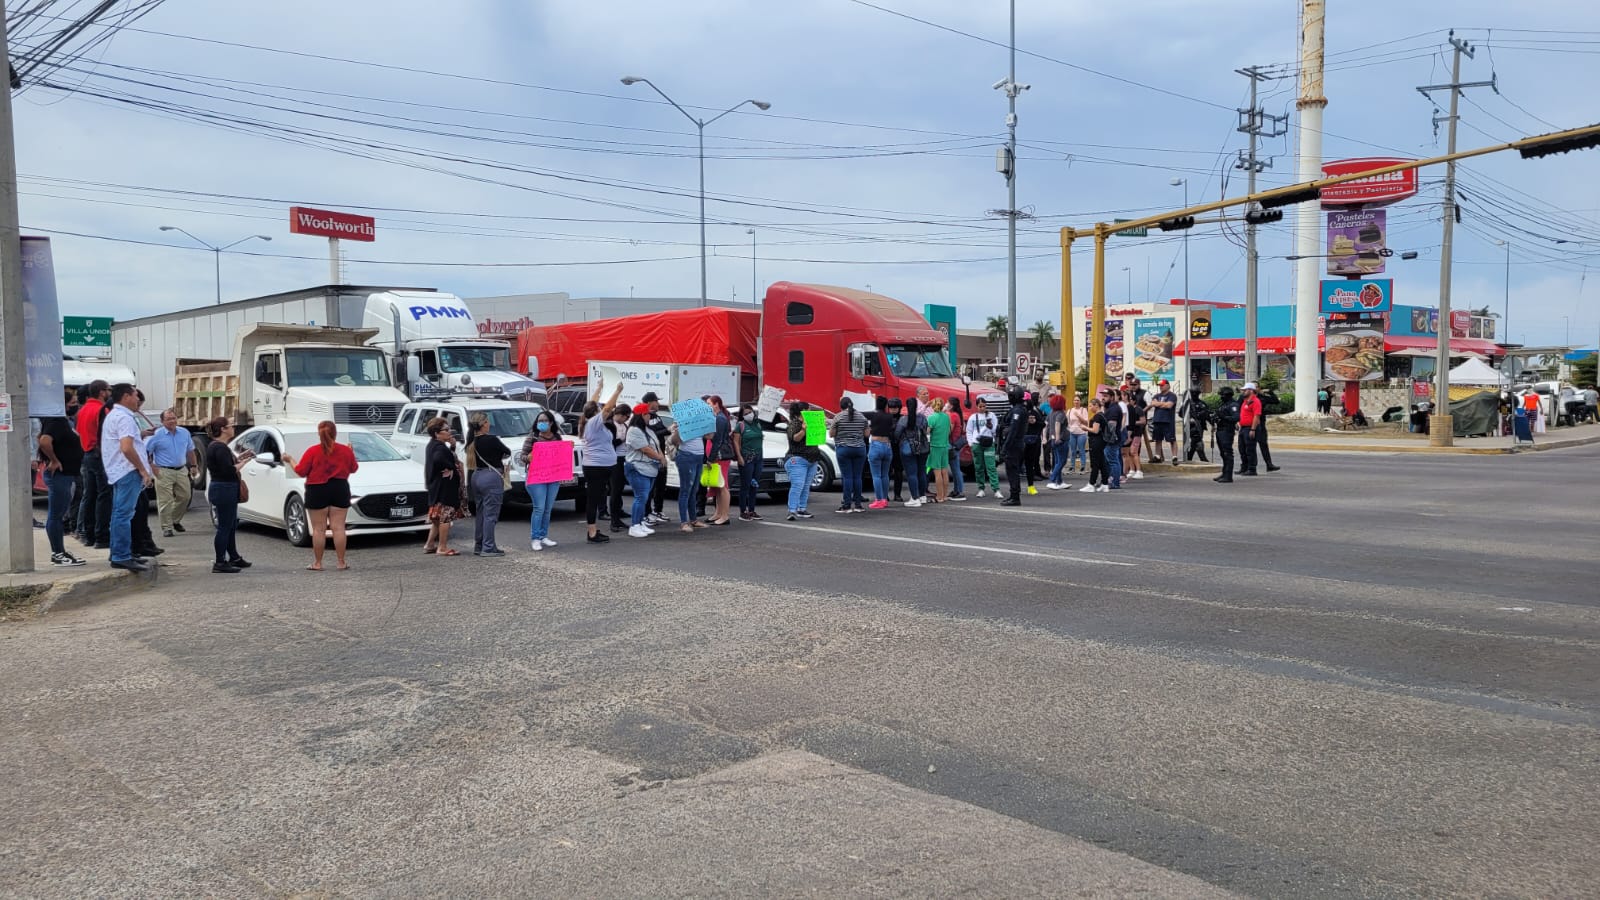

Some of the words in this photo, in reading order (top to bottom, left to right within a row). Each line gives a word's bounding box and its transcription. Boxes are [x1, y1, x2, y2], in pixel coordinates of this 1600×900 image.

[1335, 211, 1375, 221] Pasteles
[298, 213, 374, 235] Woolworth
[1329, 220, 1367, 229] Caseros
[409, 306, 472, 320] PMM
[476, 317, 534, 333] olworth
